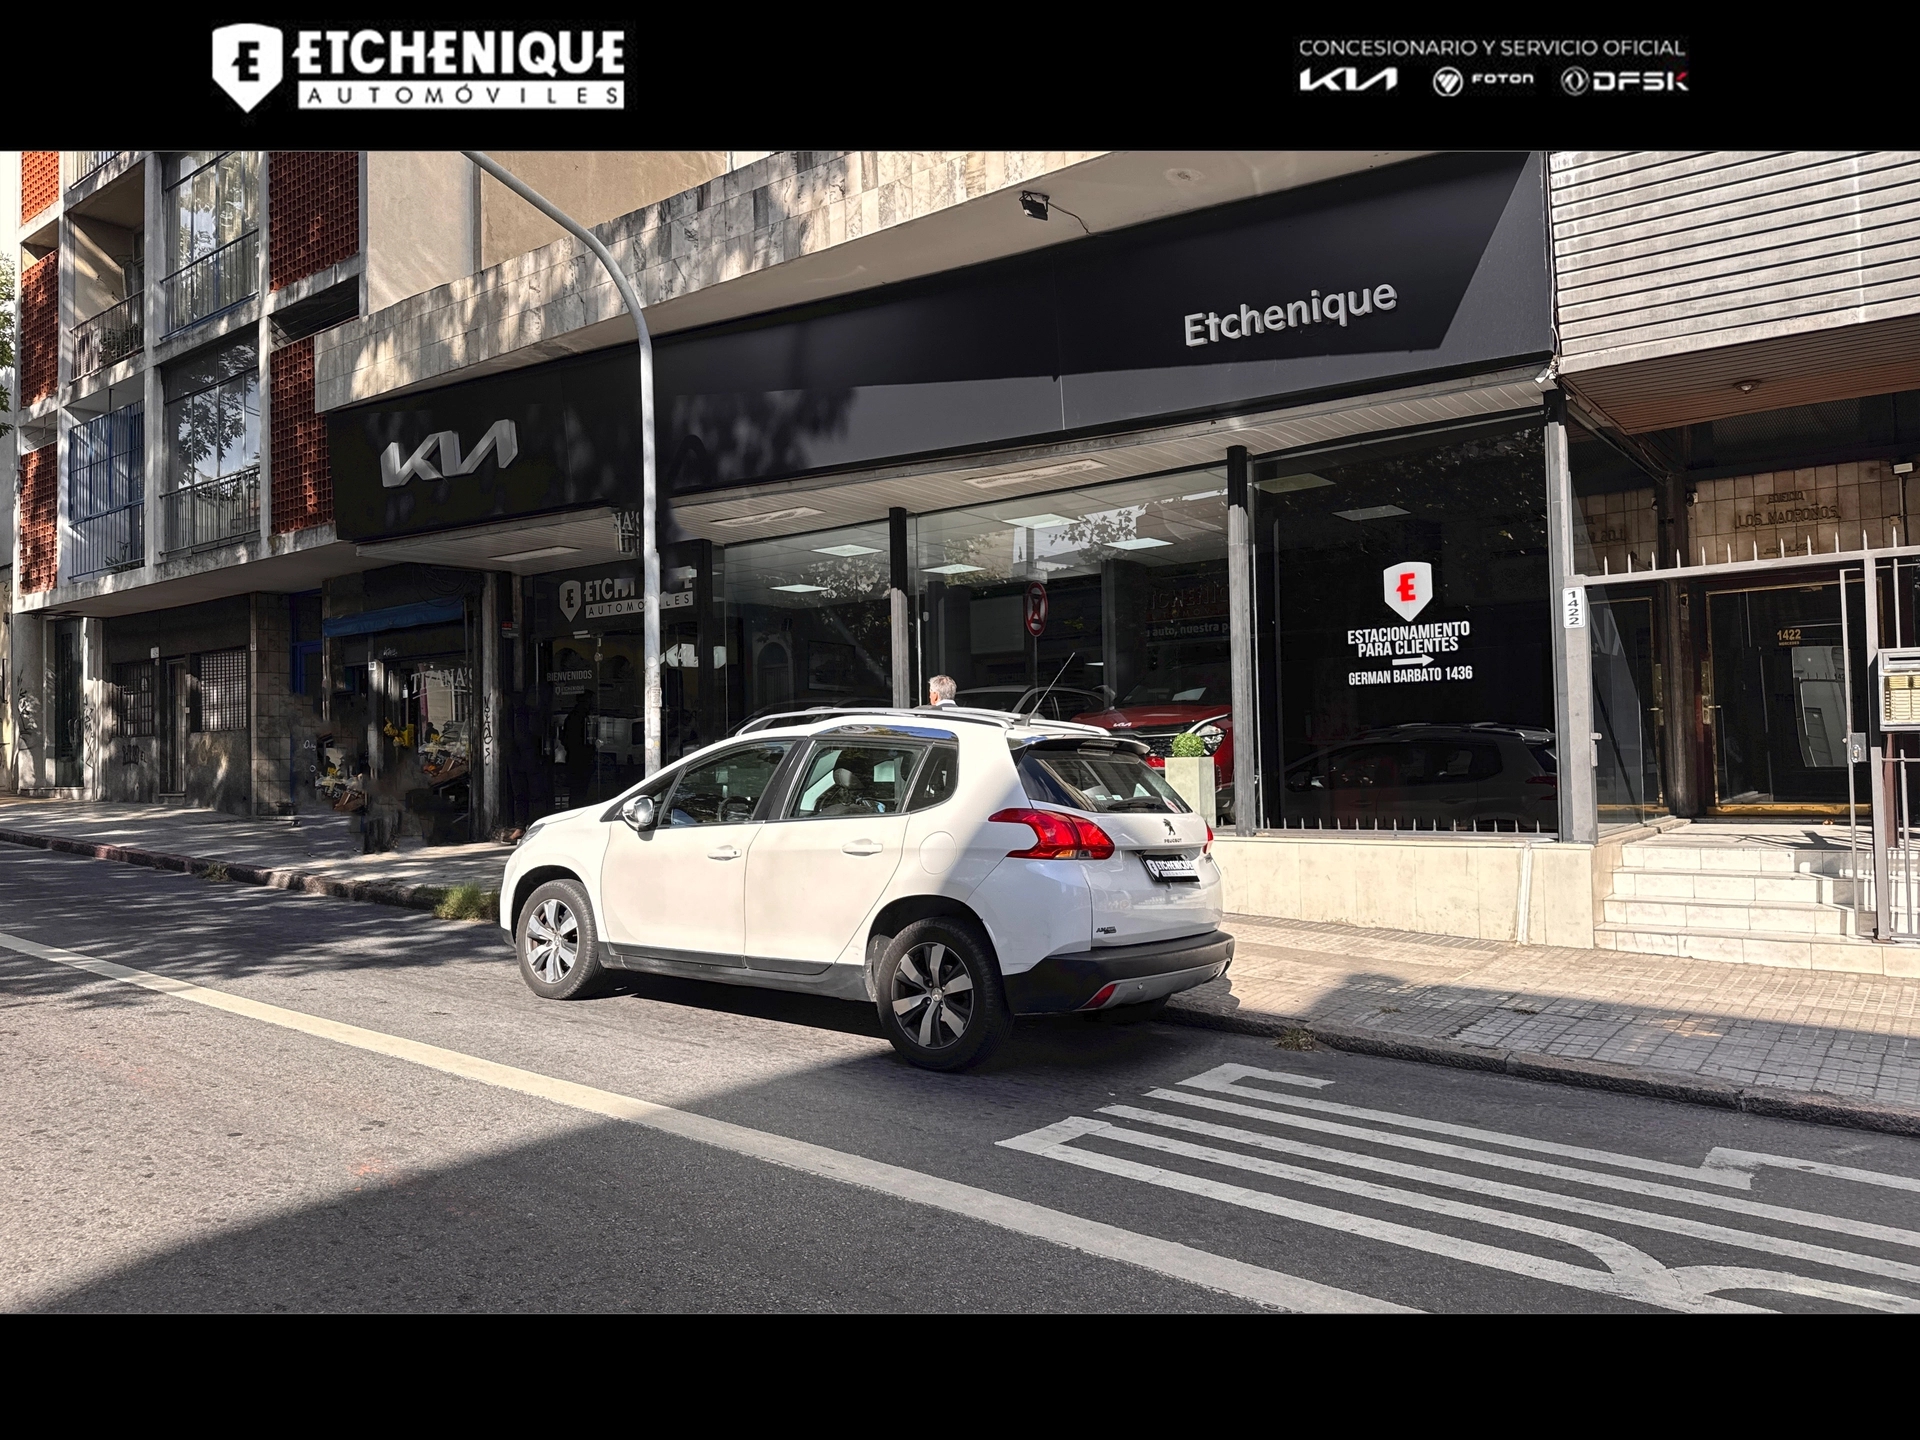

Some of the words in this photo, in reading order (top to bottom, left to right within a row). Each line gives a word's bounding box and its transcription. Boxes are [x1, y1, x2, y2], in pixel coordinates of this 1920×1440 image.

[1184, 283, 1398, 347] Etchenique
[1567, 591, 1580, 625] 1422
[1180, 623, 1219, 634] nuestra
[1347, 620, 1470, 645] ESTACIONAMIENTO
[1777, 629, 1801, 641] 1422
[1358, 642, 1392, 658] PARA
[1395, 636, 1459, 655] CLIENTES
[547, 670, 593, 682] BIENVENIDOS
[1348, 670, 1391, 686] GERMAN
[1393, 666, 1442, 683] BARBATO
[1445, 665, 1473, 681] 1436
